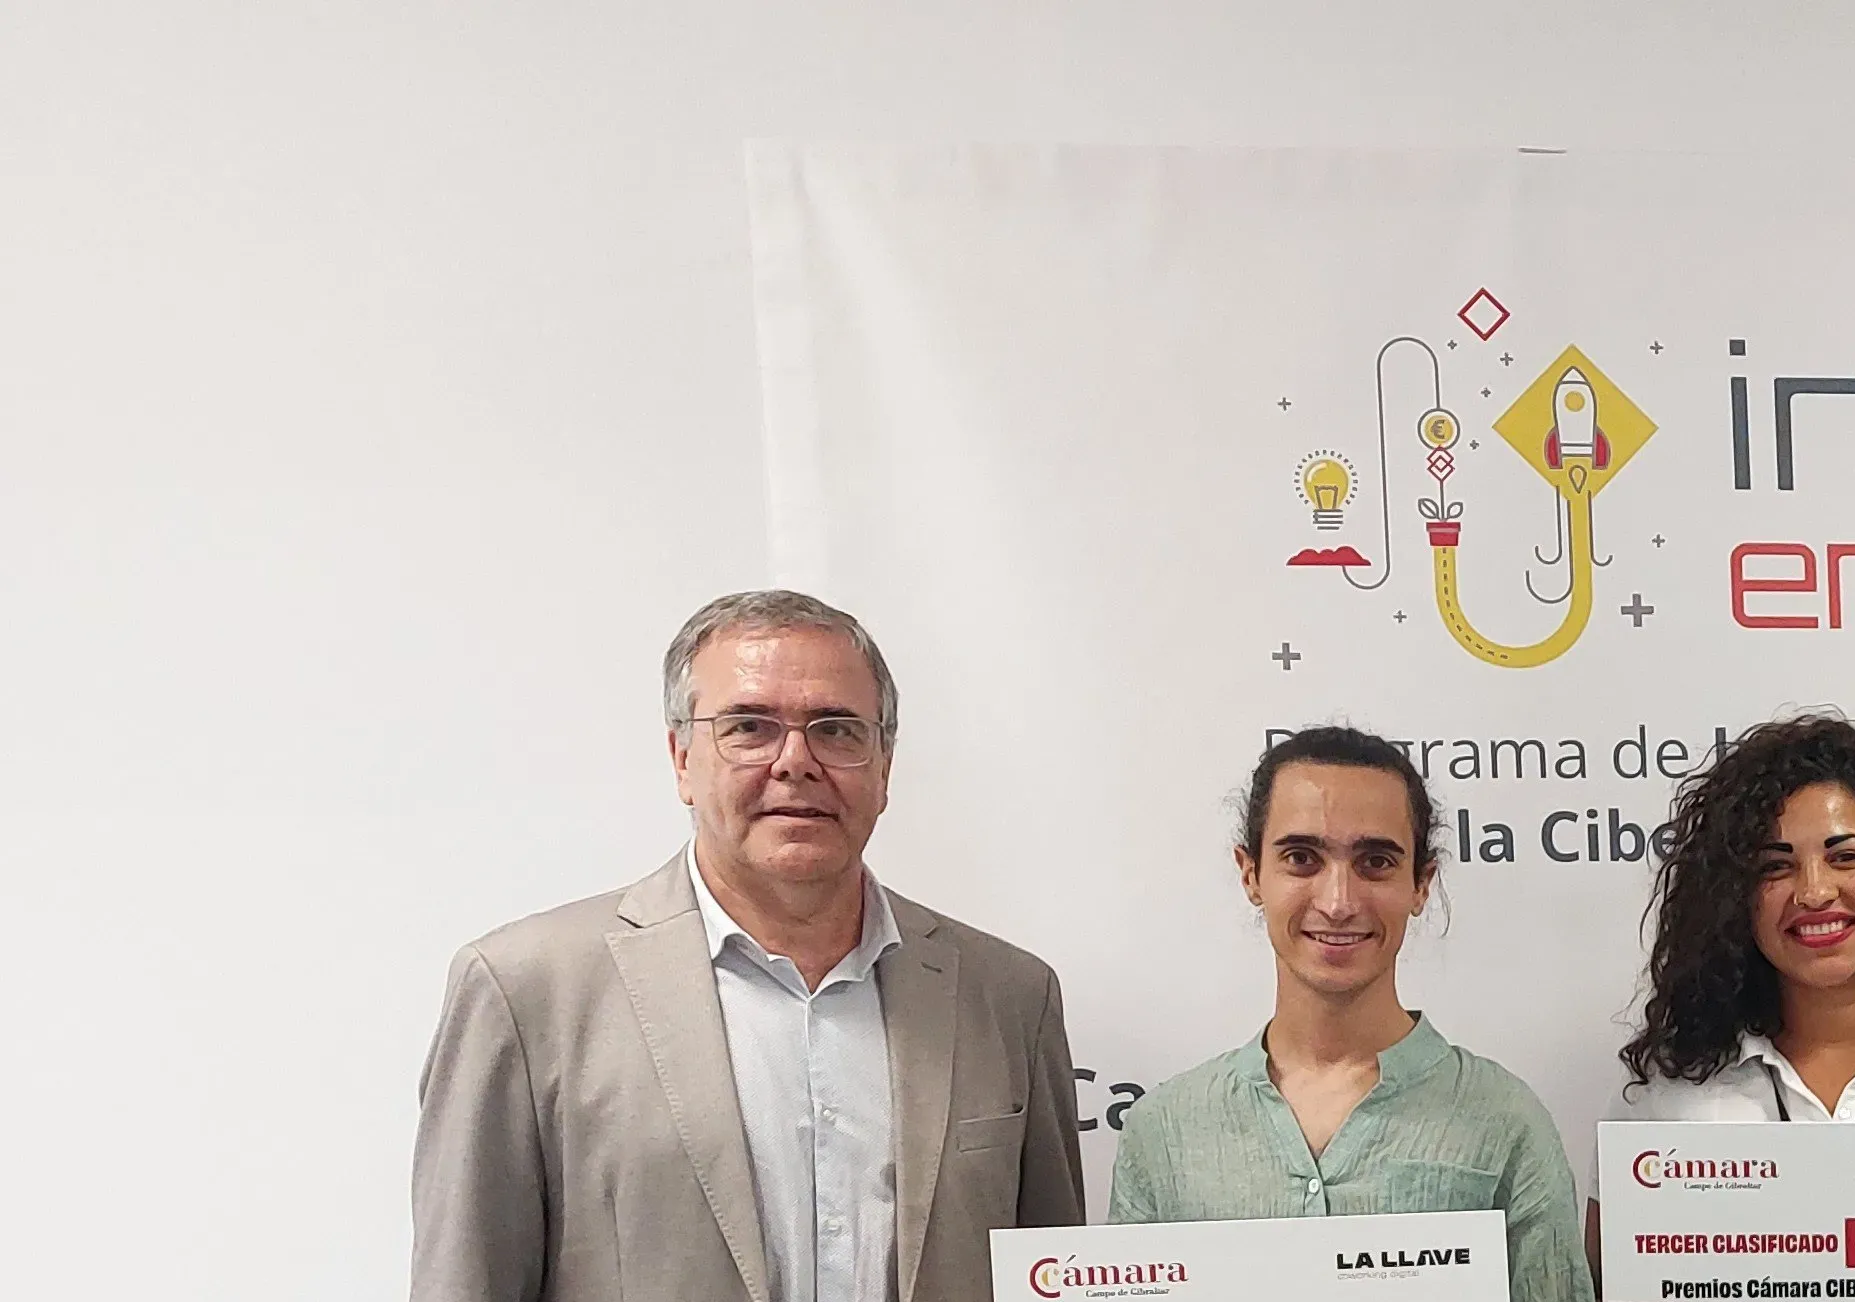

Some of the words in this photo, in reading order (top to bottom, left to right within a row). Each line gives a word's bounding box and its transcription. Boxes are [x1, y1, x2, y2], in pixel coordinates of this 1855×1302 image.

[1613, 724, 1689, 779] de
[1457, 808, 1515, 863] la
[1632, 1148, 1780, 1189] Cámara
[1336, 1252, 1374, 1270] LA
[1381, 1247, 1471, 1268] LLAVE
[1634, 1234, 1708, 1254] TERCER
[1712, 1234, 1839, 1254] CLASIFICADO
[1029, 1254, 1189, 1299] Cámara
[1661, 1278, 1742, 1298] Premios
[1747, 1276, 1822, 1298] Cámara
